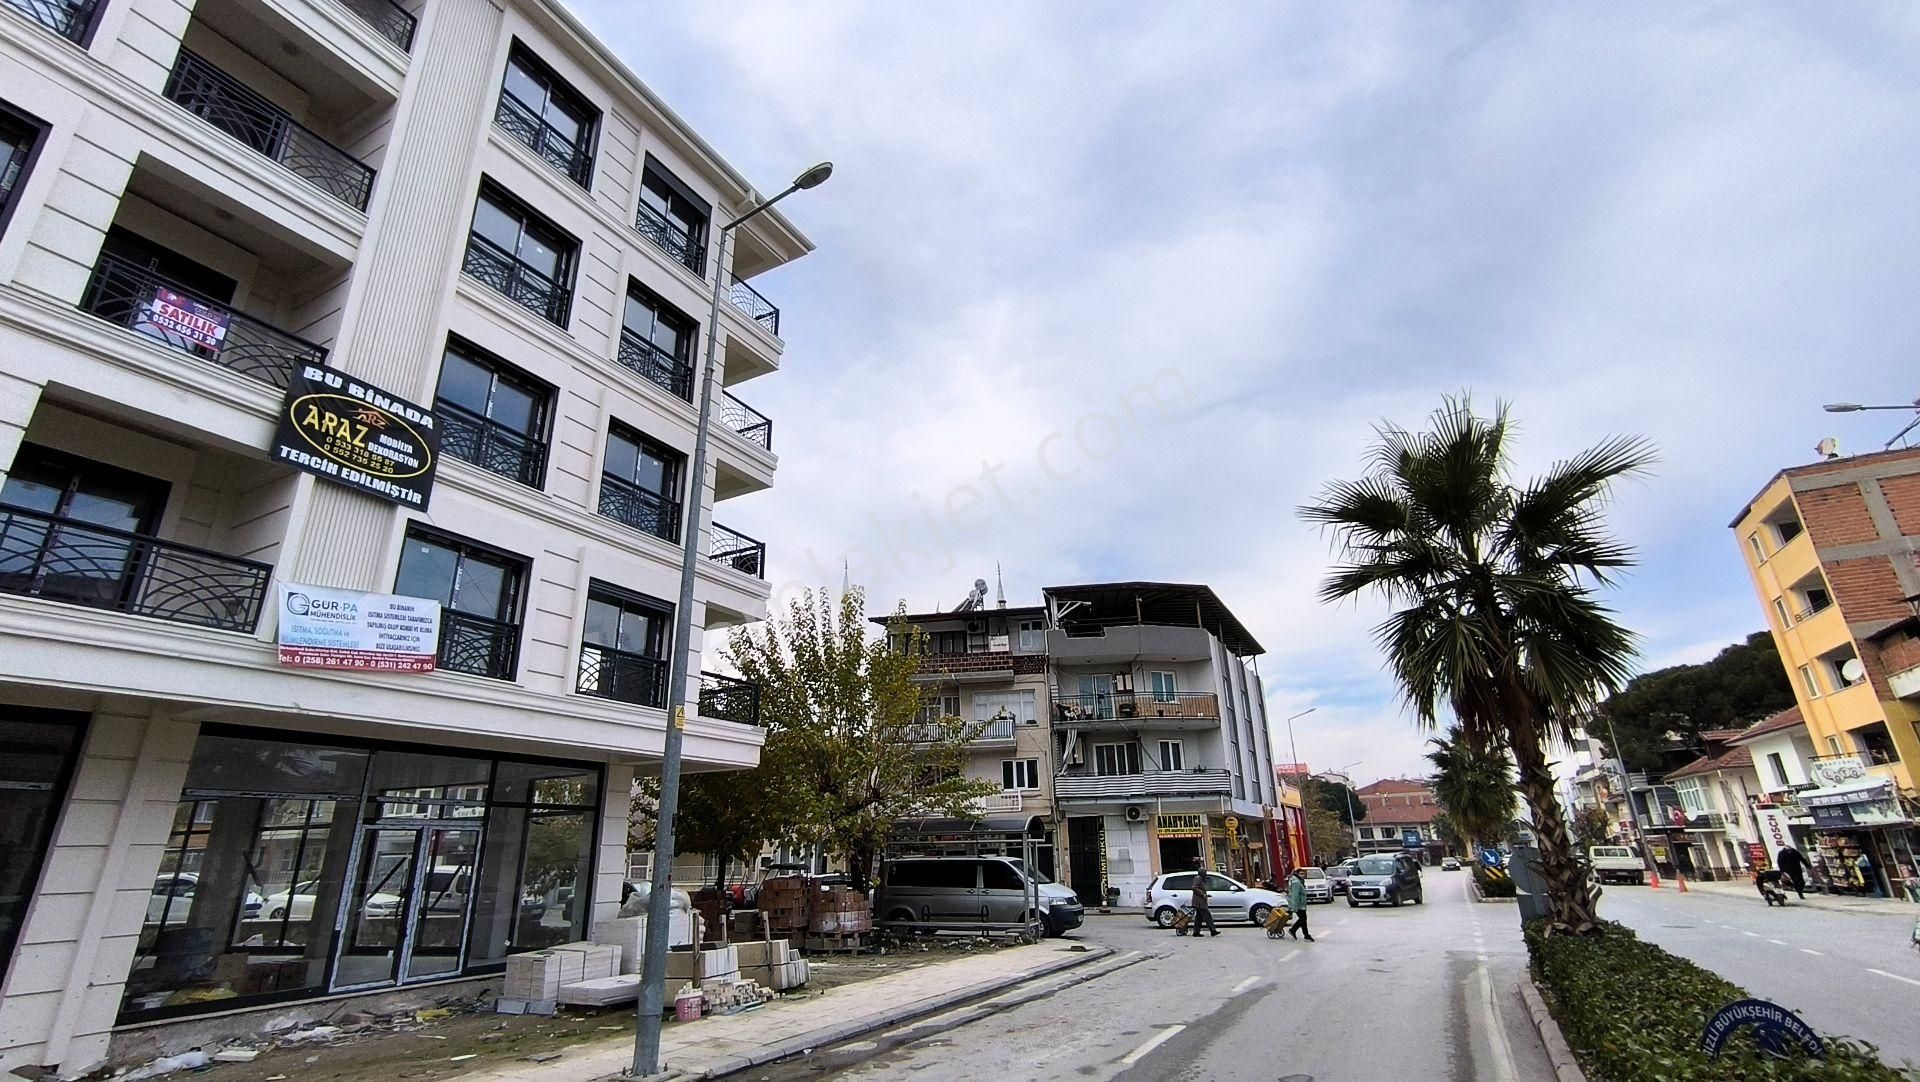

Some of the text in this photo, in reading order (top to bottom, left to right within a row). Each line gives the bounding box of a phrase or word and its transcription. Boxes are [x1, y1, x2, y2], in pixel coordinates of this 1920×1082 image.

[153, 314, 216, 346] 0532 456 31 20
[159, 304, 217, 336] SATILIK
[303, 366, 434, 430] BU BİNADA
[302, 404, 369, 448] ARAZ
[335, 440, 352, 450] 533
[368, 442, 419, 468] DEKORASYON
[379, 434, 413, 454] MOBİLYA
[332, 447, 350, 458] 552
[352, 454, 368, 464] 735
[370, 461, 381, 470] 25
[382, 466, 394, 474] 20
[280, 446, 422, 504] TERCİH EDİLMİŞTİR
[310, 610, 356, 621] MÜHENDİSLİK
[302, 656, 324, 666] (258)
[326, 658, 340, 666] 261
[378, 661, 396, 670] (531)
[1824, 768, 1859, 782] LOTO
[1158, 815, 1201, 828] ANAHTARCI
[1767, 814, 1786, 846] BOSCH
[1714, 1006, 1782, 1032] BÜYÜKŞEHİR
